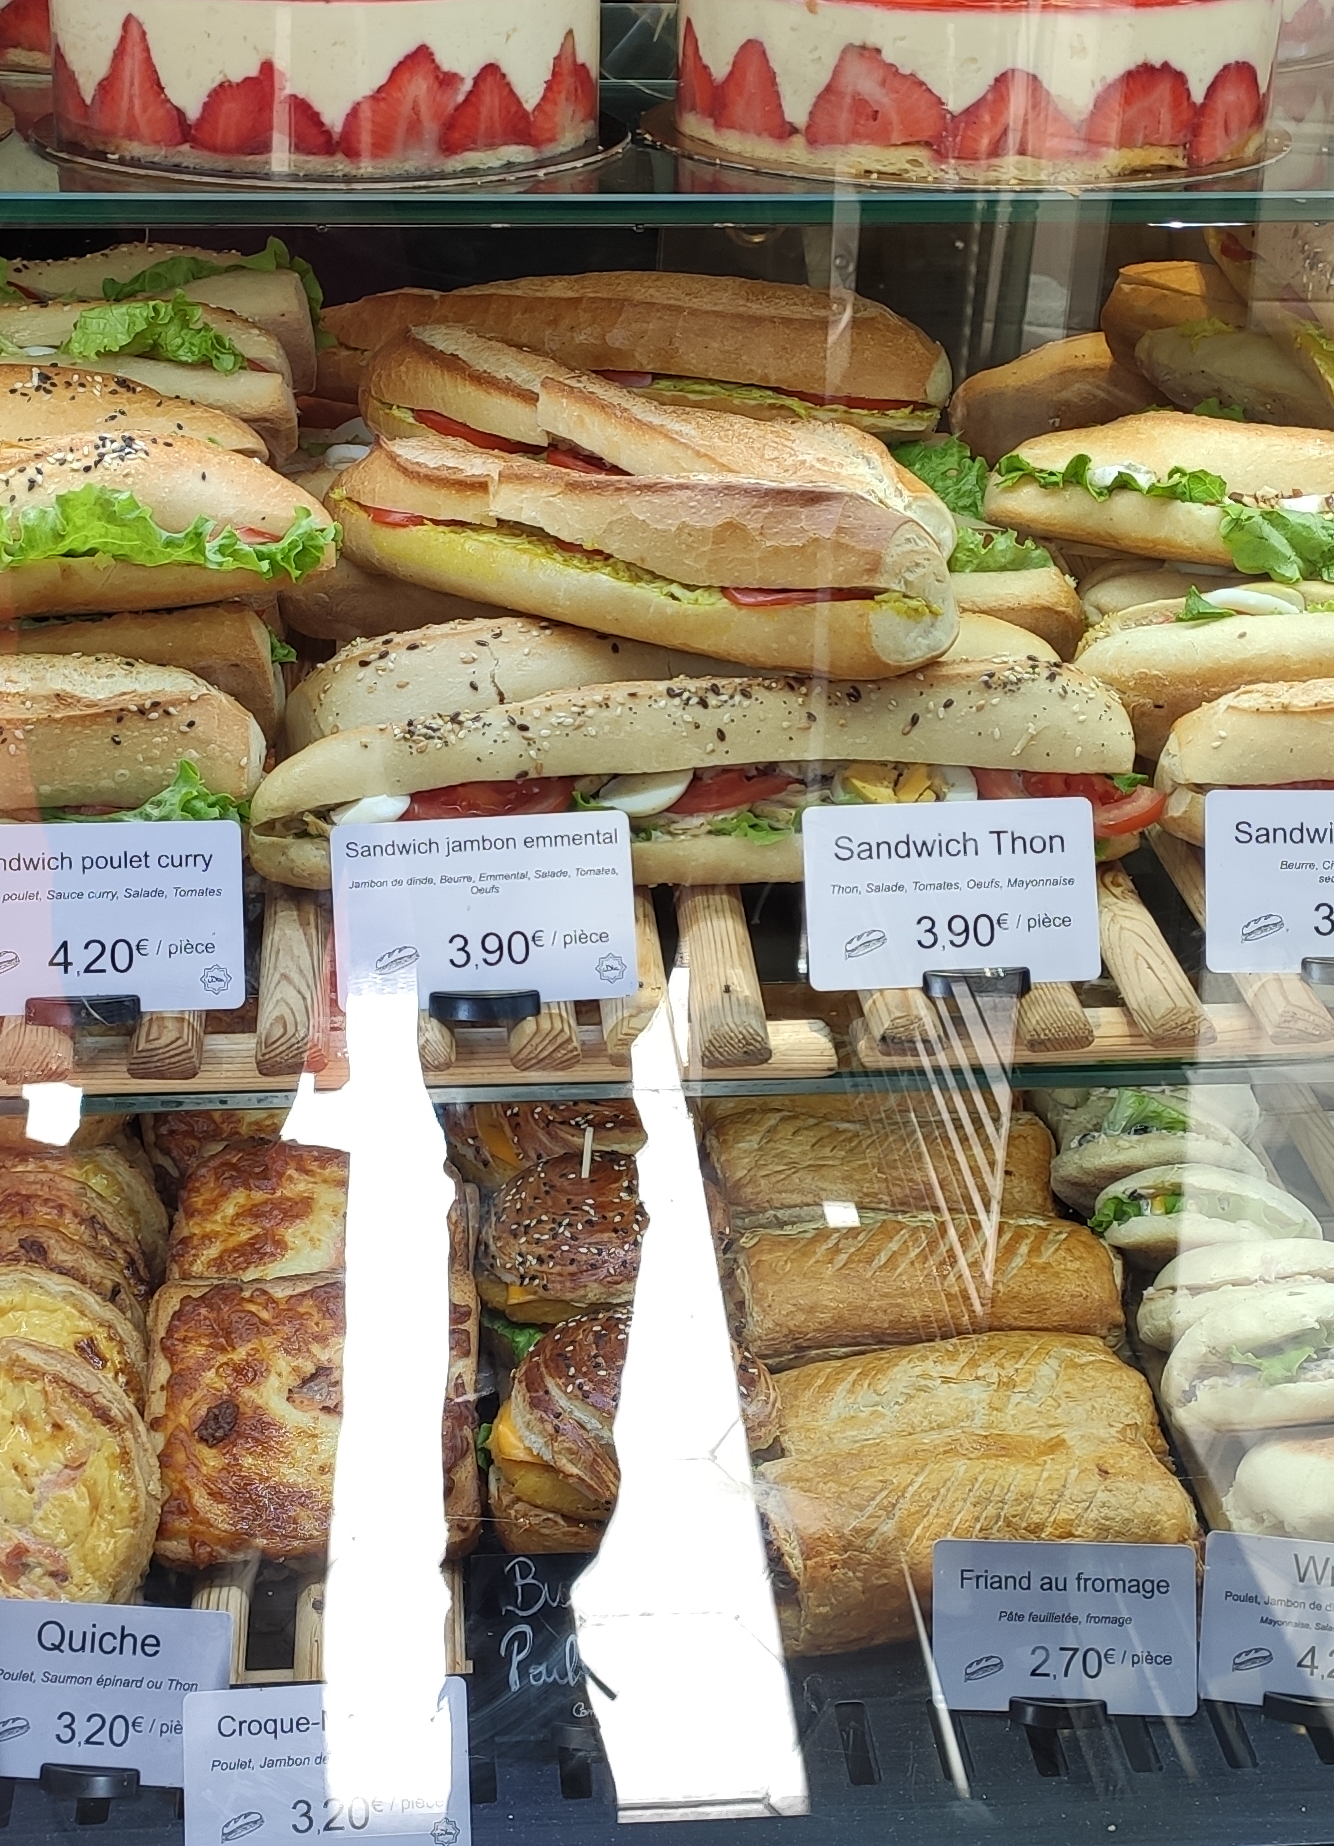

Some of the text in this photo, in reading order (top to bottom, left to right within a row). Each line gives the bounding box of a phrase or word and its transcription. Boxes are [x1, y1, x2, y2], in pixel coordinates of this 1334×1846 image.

[346, 828, 617, 858] Sandwich jambon emmental
[834, 831, 1064, 861] Sandwich Thon
[82, 851, 150, 874] poulet
[158, 854, 213, 872] curry
[1280, 861, 1318, 870] Beurre,
[349, 880, 387, 889] Jambon
[407, 877, 436, 886] dinde,
[440, 875, 475, 883] Beurre,
[479, 871, 530, 881] Emmental,
[534, 869, 571, 879] Salade,
[576, 867, 618, 876] Tomates,
[471, 885, 499, 894] Oeufs
[831, 876, 1074, 894] Thon, Salade, Tomates, Oeufs, Mayonnaise
[2, 891, 41, 903] poulet,
[47, 890, 84, 900] Sauce
[88, 891, 118, 901] curry,
[124, 888, 167, 899] Salade,
[173, 887, 222, 897] Tomates
[917, 913, 1071, 951] 3,90€ / pièce
[48, 939, 215, 976] 4,20€ / pièce
[449, 929, 609, 970] 3,90€ / pièce
[961, 1569, 1170, 1599] Friand au fromage
[1225, 1591, 1260, 1605] Poulet,
[1263, 1596, 1305, 1609] Jambon
[1309, 1601, 1322, 1611] de
[998, 1611, 1132, 1627] Pâte feuilletée, fromage
[1260, 1616, 1311, 1629] Mayonnaise,
[38, 1621, 160, 1657] Quiche
[499, 1623, 588, 1692] Poul
[1030, 1646, 1172, 1680] 2,70€ / pièce
[41, 1671, 92, 1685] Saumon
[96, 1674, 144, 1689] épinard
[147, 1680, 163, 1689] ou
[168, 1679, 198, 1692] Thon
[55, 1712, 183, 1747] 3,20€ / piè
[218, 1710, 327, 1739] Croque-
[211, 1758, 254, 1771] Poulet,
[259, 1756, 310, 1768] Jambon
[291, 1797, 383, 1835] 3,20€
